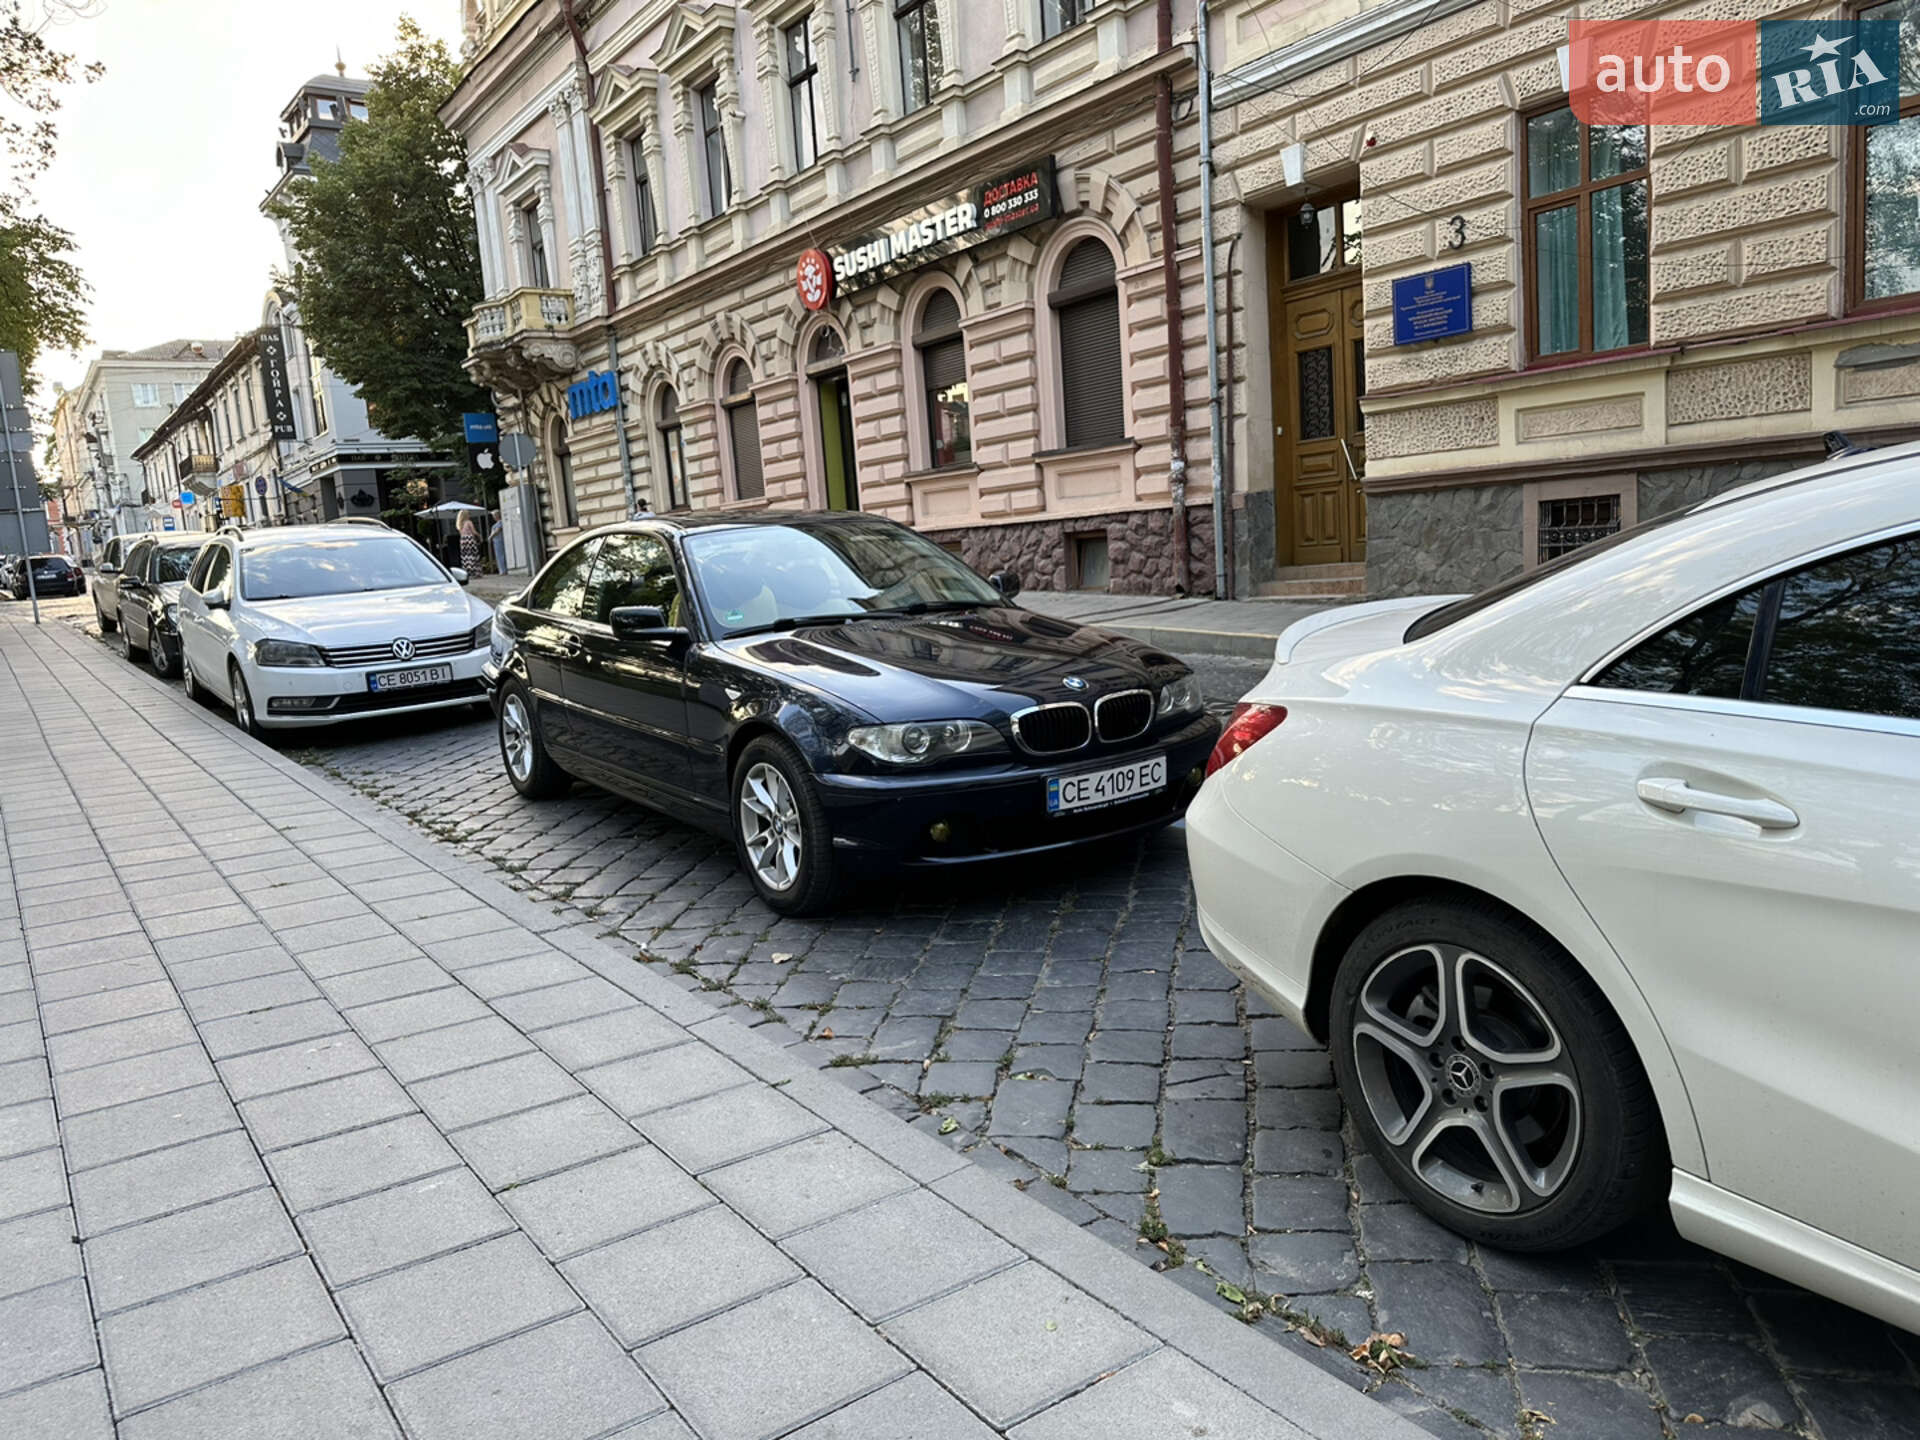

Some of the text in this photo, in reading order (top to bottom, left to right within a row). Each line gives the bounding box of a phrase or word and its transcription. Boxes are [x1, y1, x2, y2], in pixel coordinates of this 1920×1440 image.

[984, 171, 1038, 207] ДОСТАВКА
[984, 207, 990, 218] 0
[991, 200, 1007, 216] 800
[833, 201, 979, 282] SUSHI MASTER
[1448, 214, 1467, 250] 3
[567, 371, 617, 419] mta
[273, 425, 293, 433] PUB
[377, 674, 397, 688] CE
[399, 670, 428, 685] 8051
[1062, 778, 1091, 804] CE
[1094, 768, 1136, 798] 4109
[1139, 762, 1162, 788] EC
